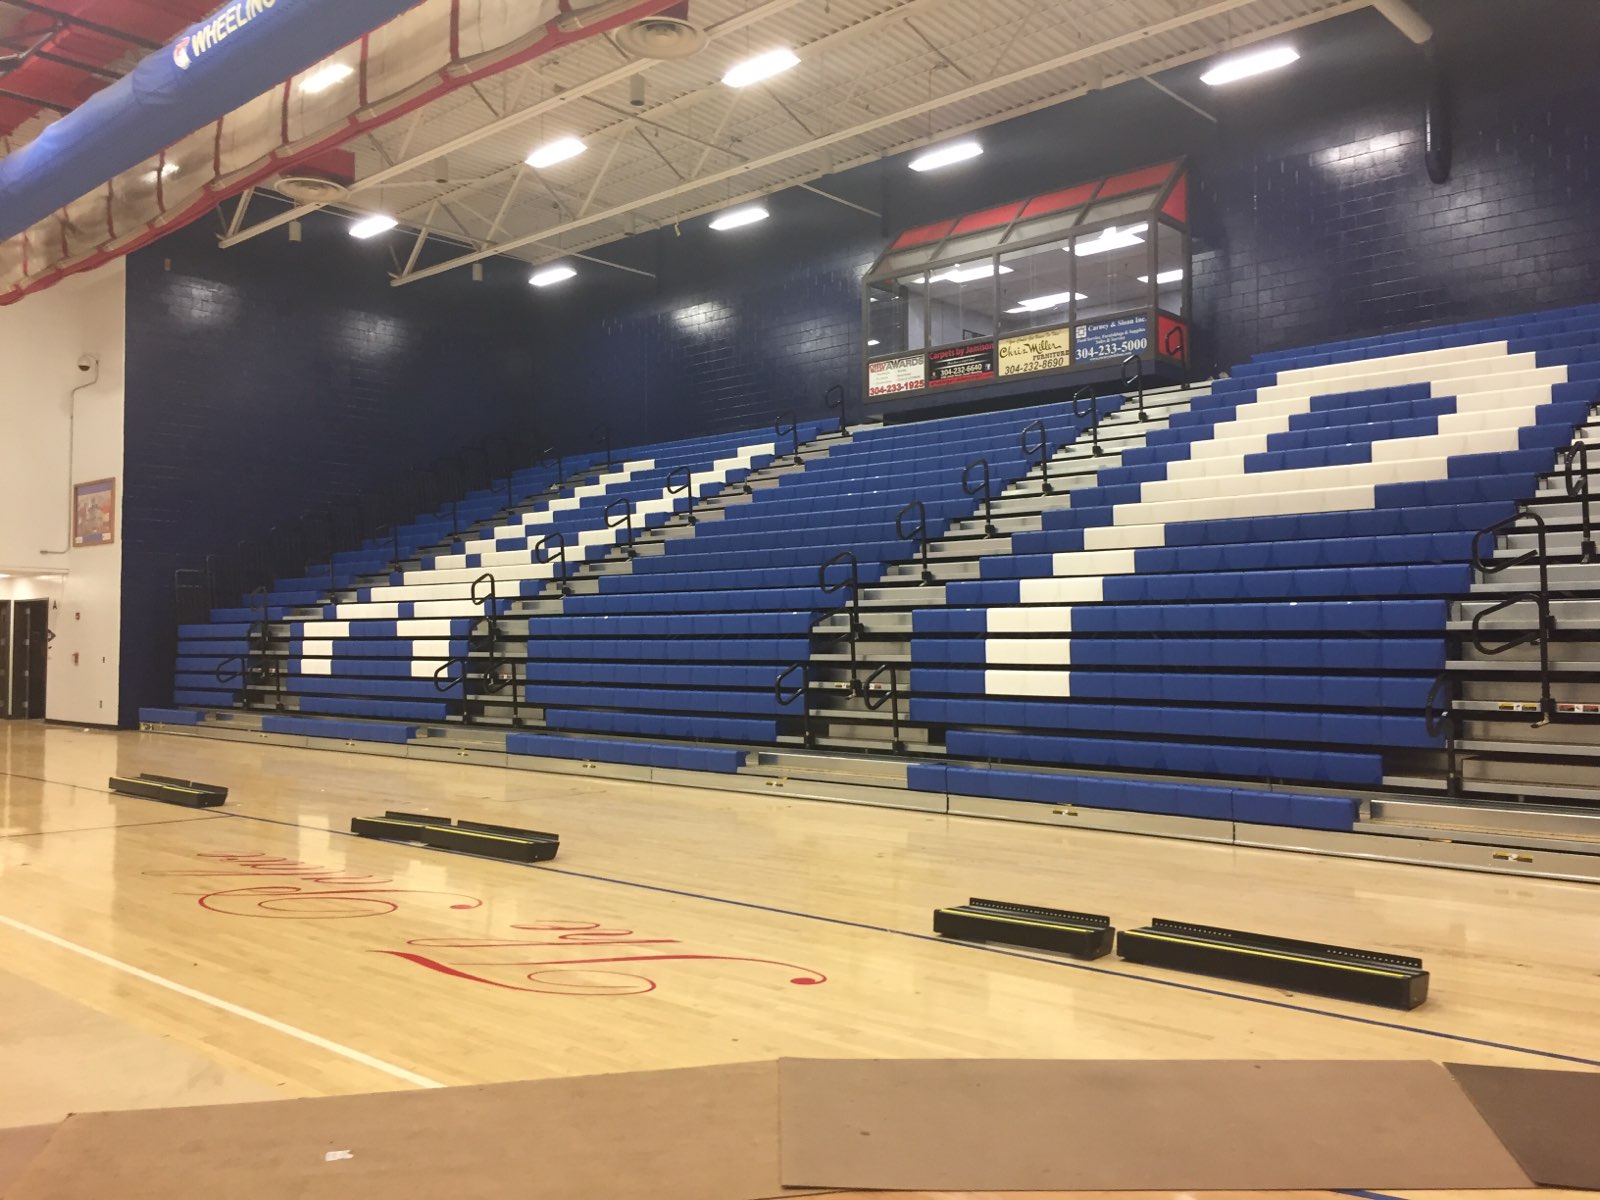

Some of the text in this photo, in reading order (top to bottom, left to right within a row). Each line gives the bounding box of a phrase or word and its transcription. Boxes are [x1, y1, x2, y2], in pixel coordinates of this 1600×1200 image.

[928, 350, 955, 360] Carpets
[955, 348, 965, 356] by
[1024, 340, 1062, 354] Miller
[1075, 338, 1148, 360] 304-233-5000
[1033, 350, 1070, 361] FURNITURE
[886, 357, 925, 371] AWARDS
[1005, 357, 1064, 375] 304-232-8690
[870, 380, 925, 395] 304-233-1925
